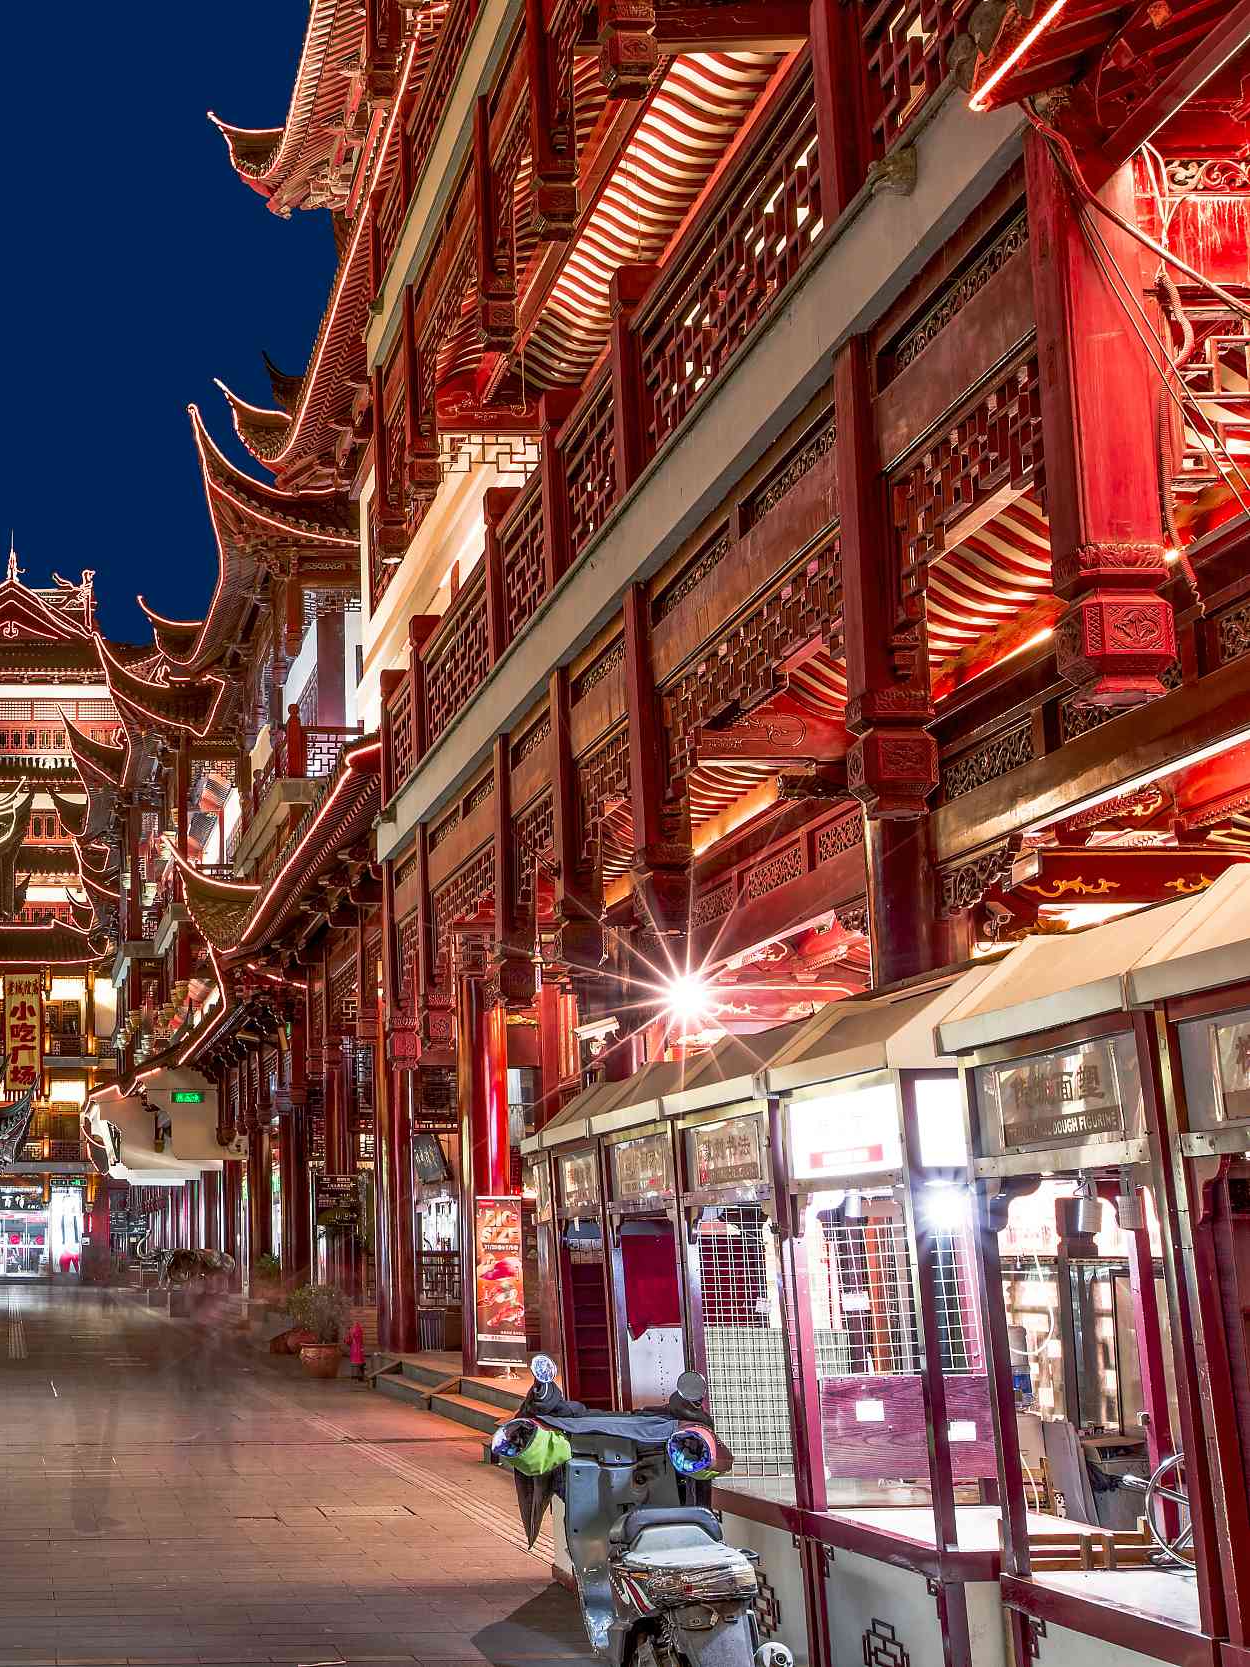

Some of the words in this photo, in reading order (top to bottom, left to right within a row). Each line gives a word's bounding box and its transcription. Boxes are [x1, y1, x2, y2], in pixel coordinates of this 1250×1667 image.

[10, 1001, 36, 1085] 小吃广场
[1053, 1115, 1079, 1134] DOUGH
[481, 1227, 518, 1243] SIZE
